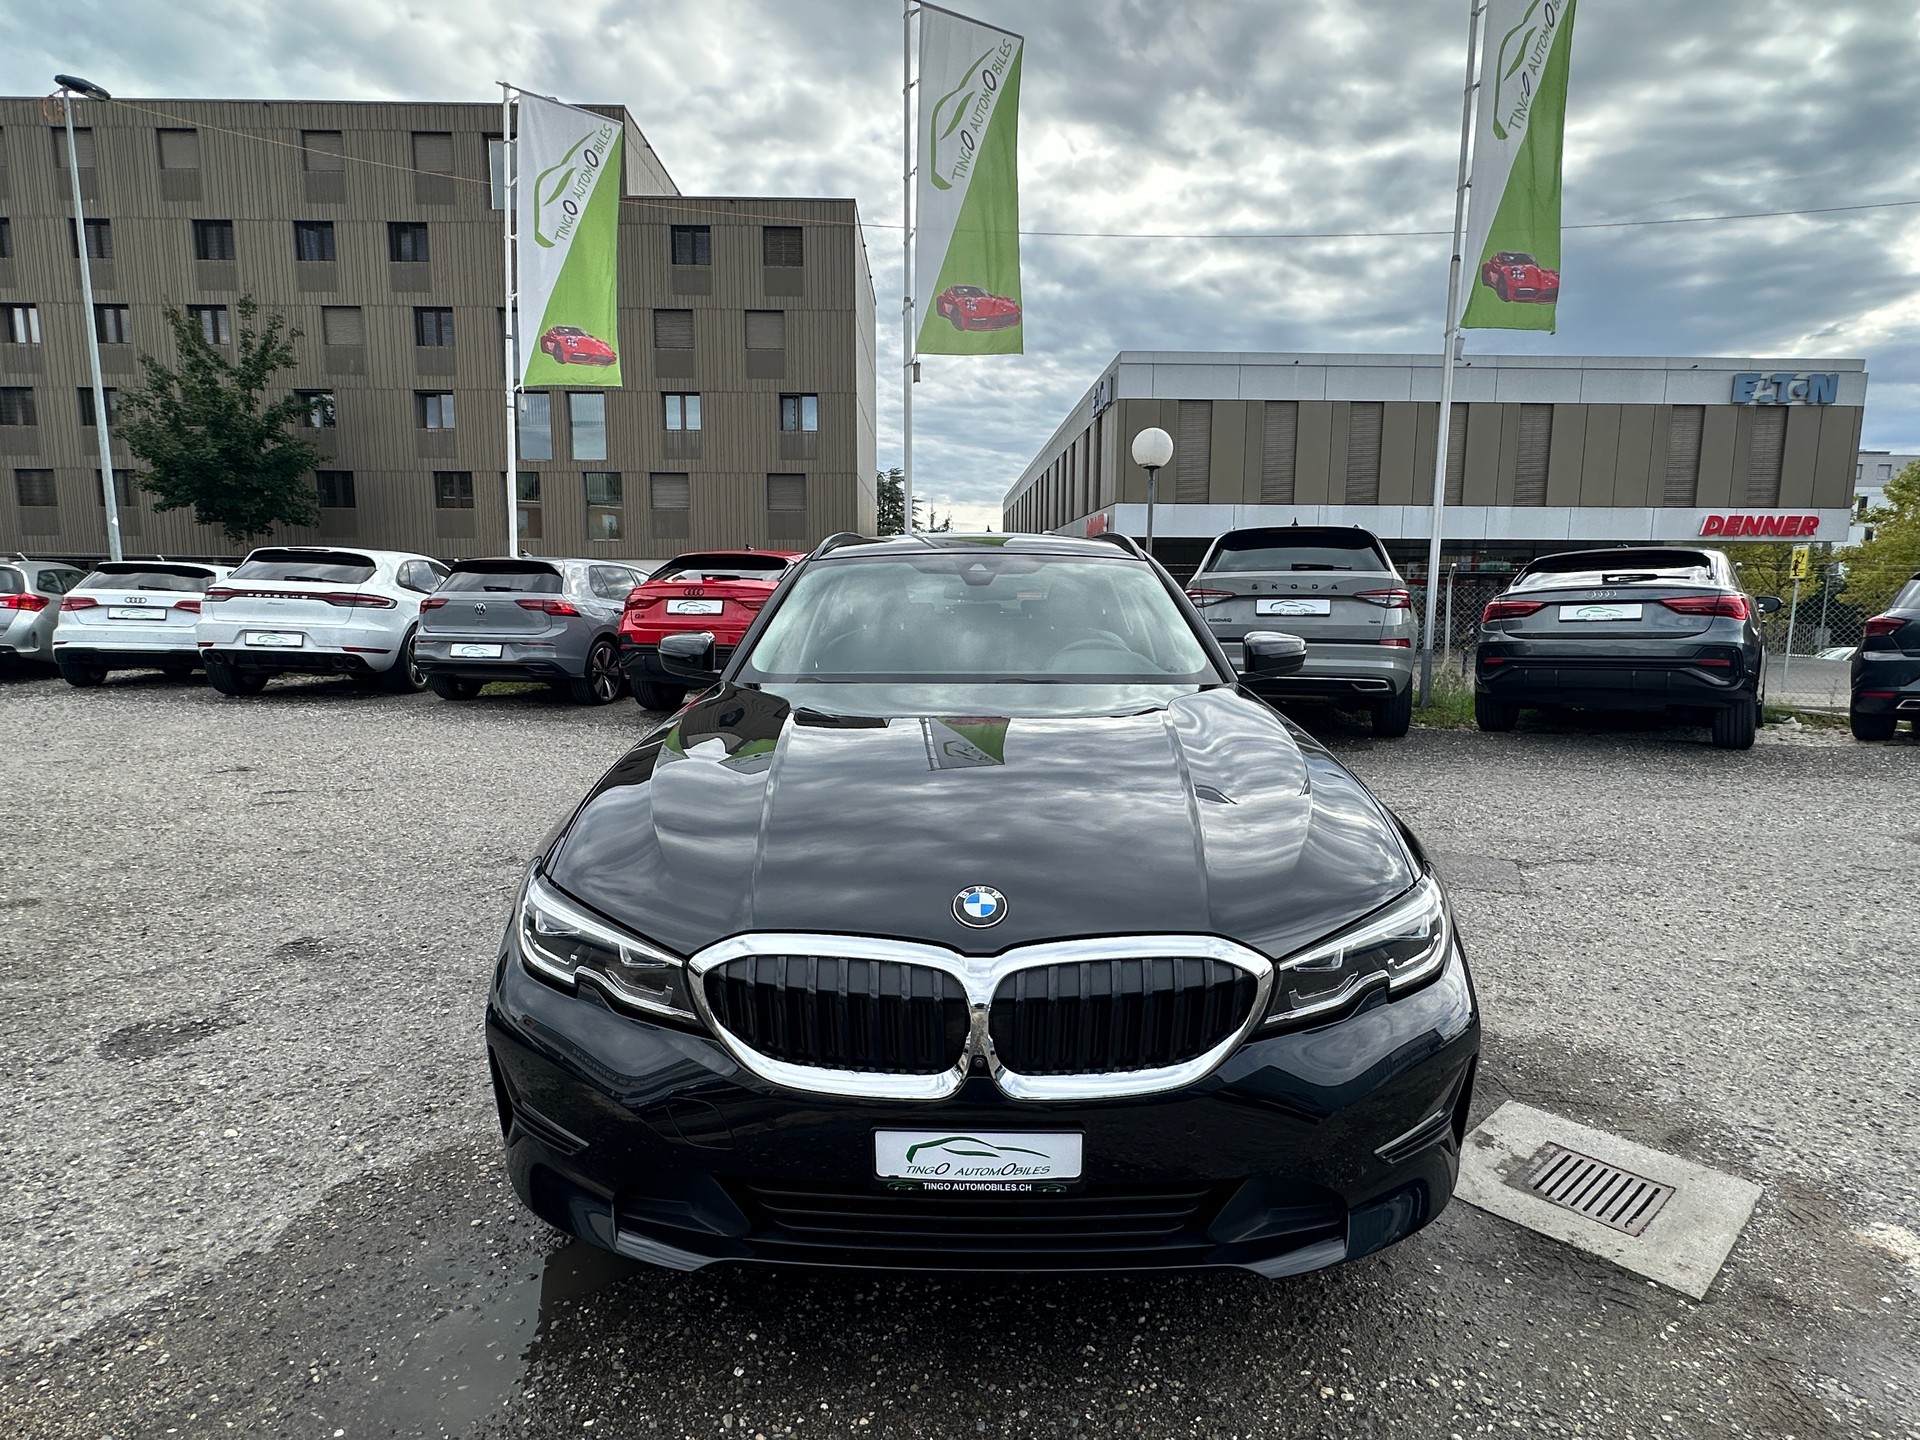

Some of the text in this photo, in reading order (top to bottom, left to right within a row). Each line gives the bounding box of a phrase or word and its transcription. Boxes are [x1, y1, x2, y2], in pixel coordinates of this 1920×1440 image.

[952, 38, 1013, 180] TINGO AUTOMOBILES
[1508, 71, 1531, 129] TINGO
[554, 123, 614, 241] TINGO AUTOMOBILES
[1732, 373, 1840, 405] EATON
[1700, 515, 1820, 537] DENNER
[958, 885, 1004, 900] BMW
[905, 1162, 1051, 1176] TINGO AUTOMOBILES
[922, 1182, 1032, 1192] TINGO AUTOMOBILES.CH
